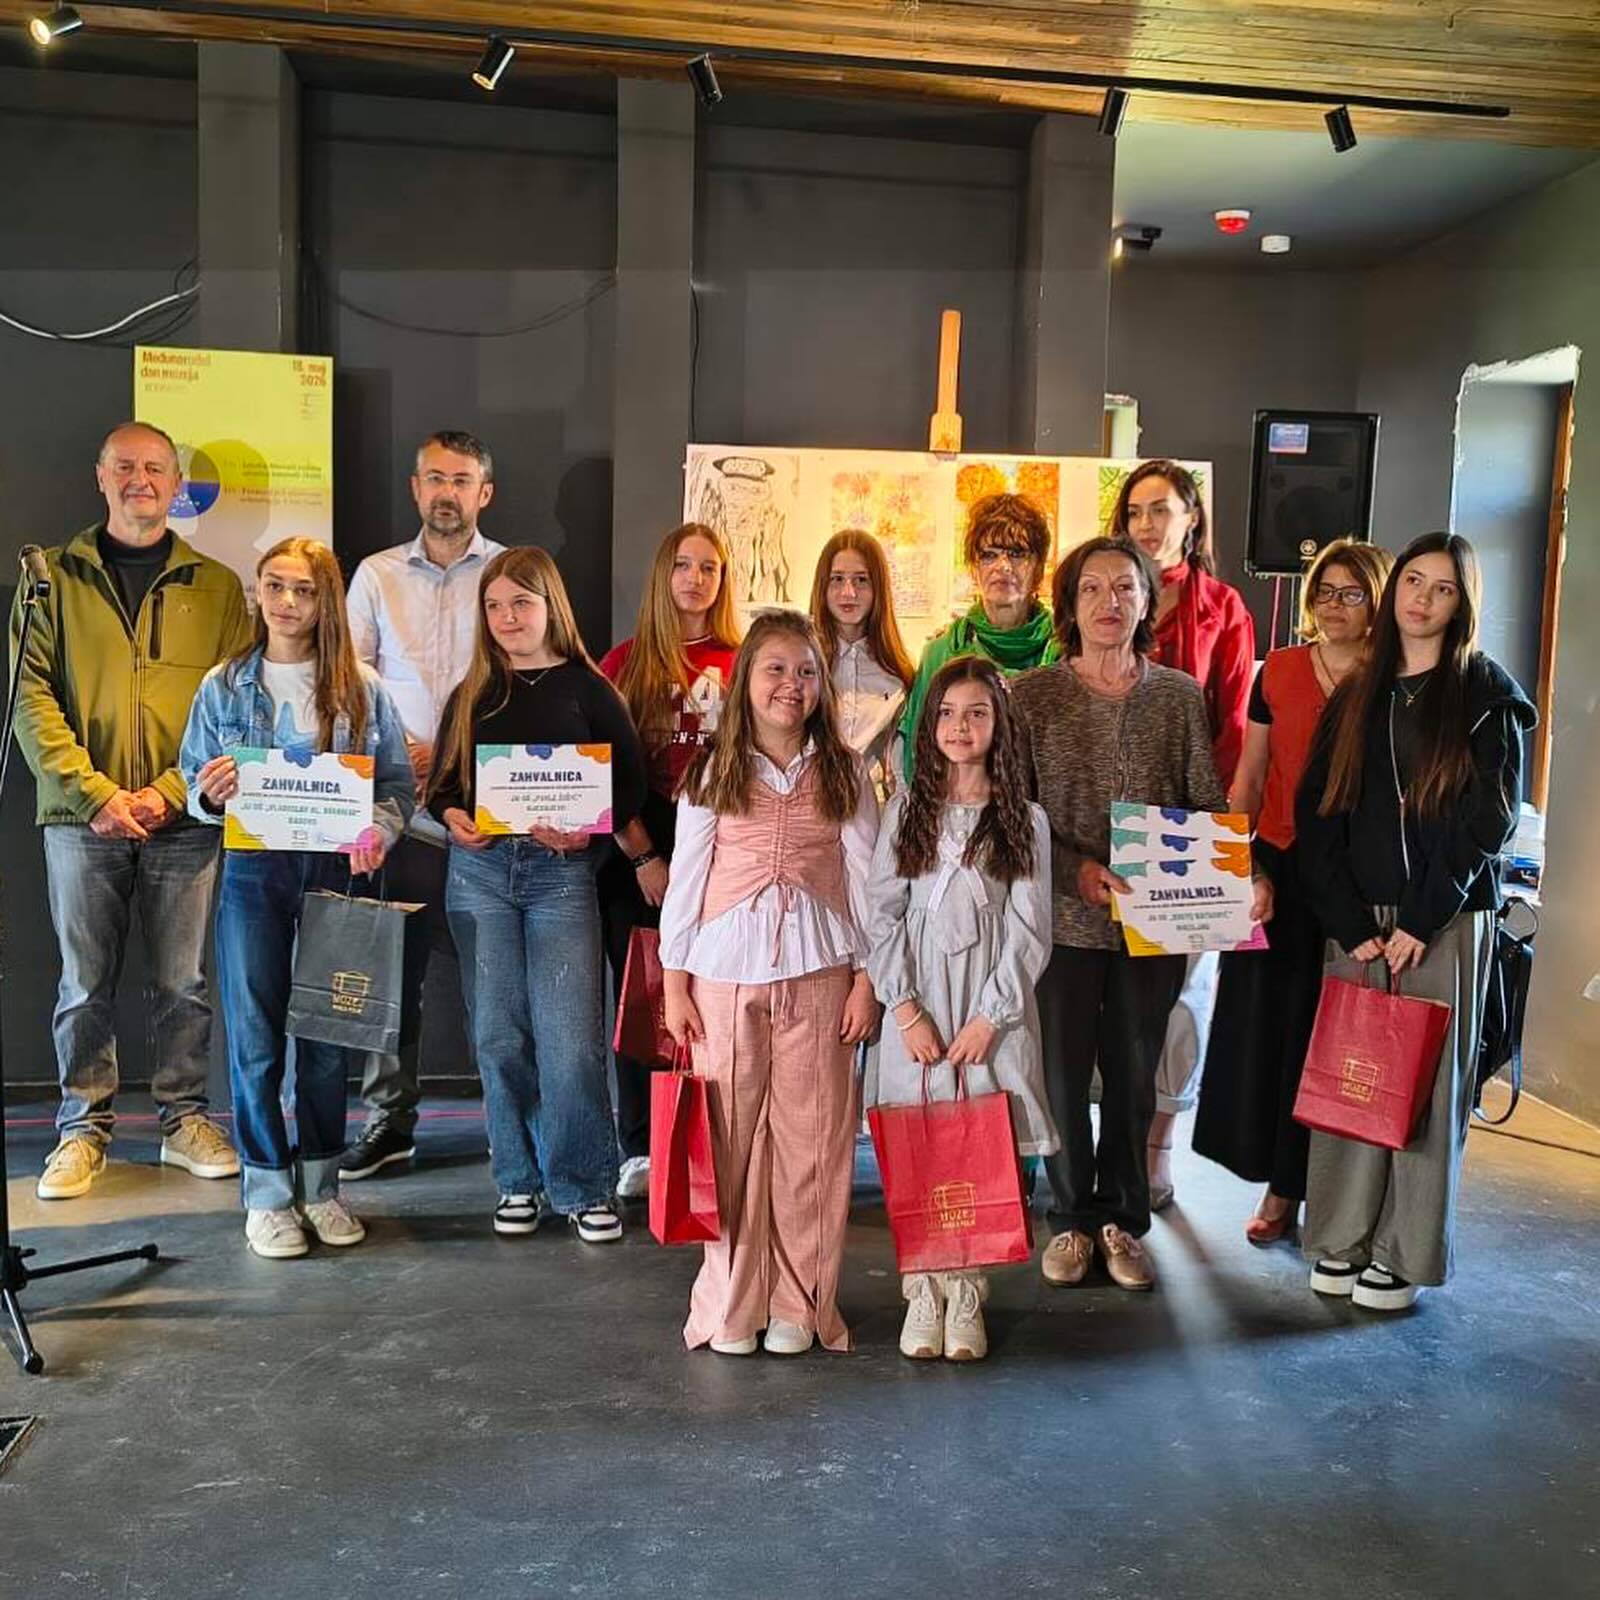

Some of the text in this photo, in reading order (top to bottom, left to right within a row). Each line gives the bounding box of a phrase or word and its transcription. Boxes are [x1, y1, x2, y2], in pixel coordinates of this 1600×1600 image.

[510, 770, 582, 783] ZAHVALNICA
[262, 777, 341, 795] ZAHVALNICA
[1149, 886, 1225, 902] ZAHVALNICA
